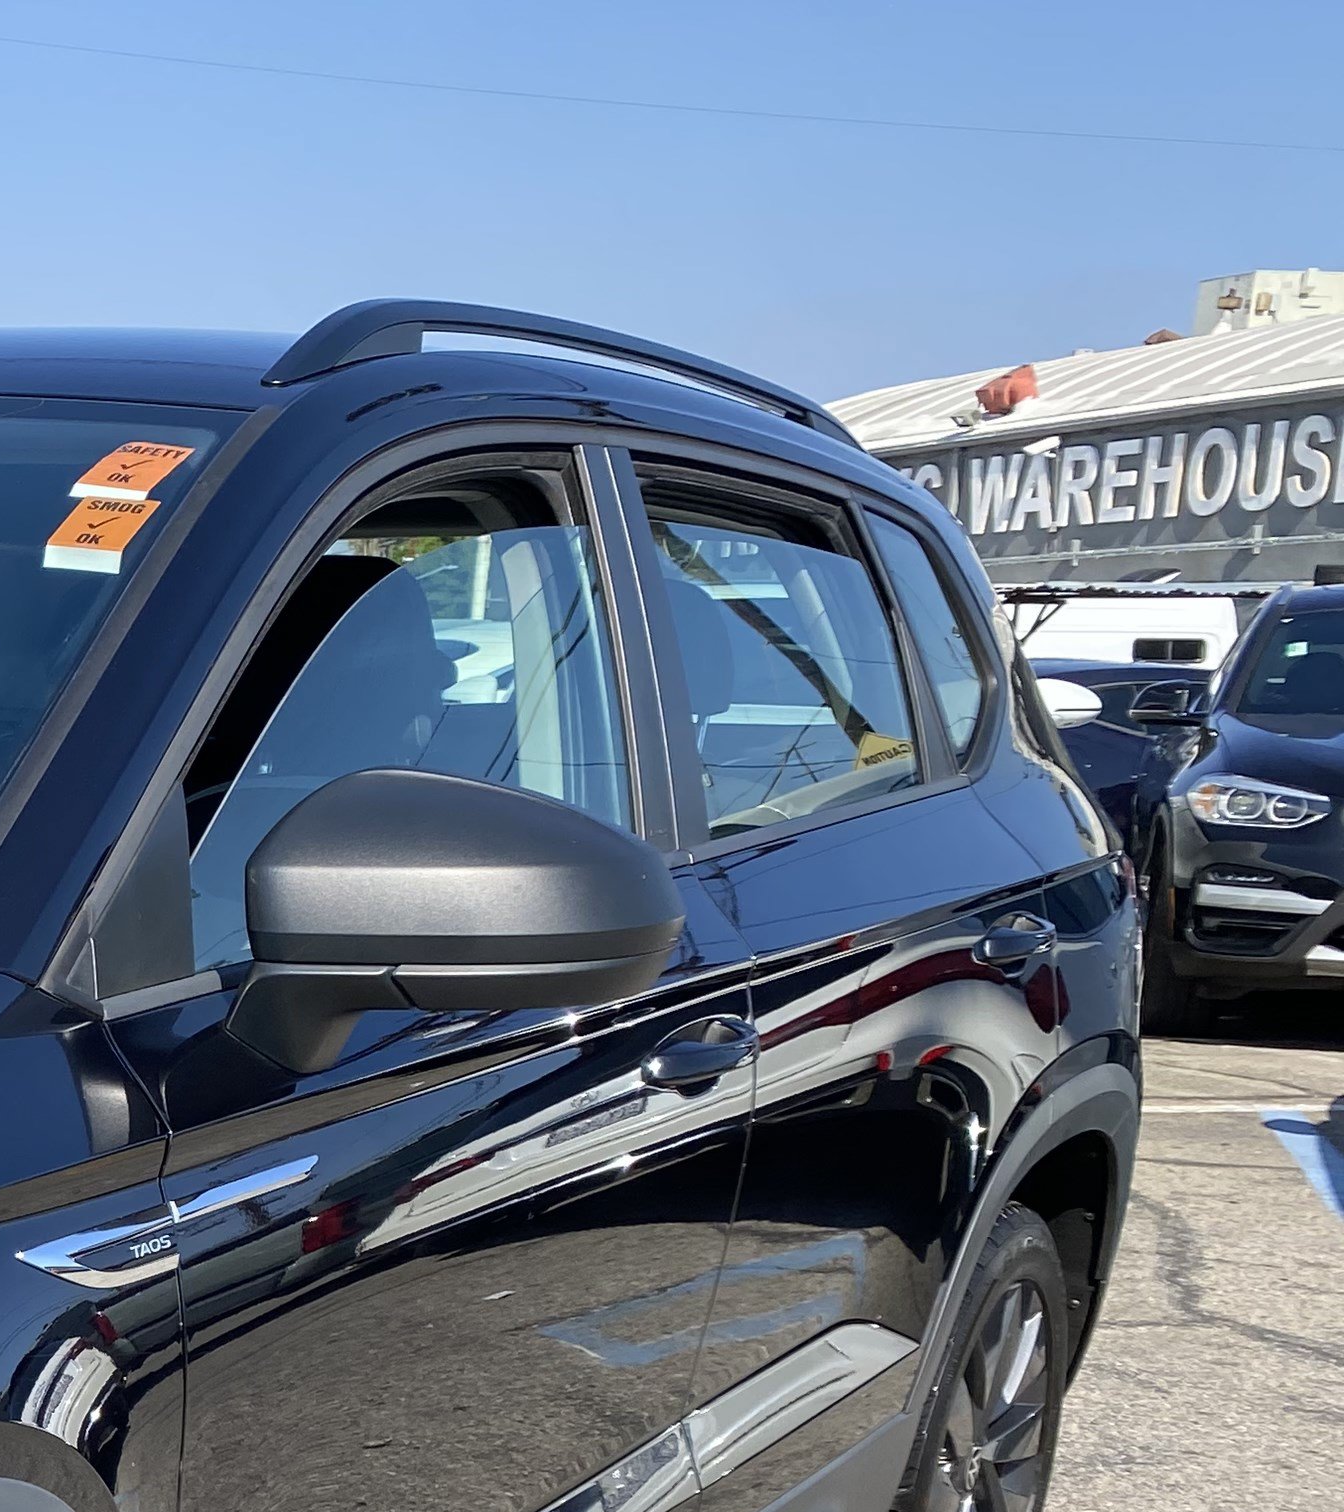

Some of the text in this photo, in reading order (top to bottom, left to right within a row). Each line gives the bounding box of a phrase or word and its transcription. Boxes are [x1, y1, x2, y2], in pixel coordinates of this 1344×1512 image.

[116, 445, 186, 459] SAFETY
[106, 472, 136, 484] OK
[968, 414, 1344, 536] WAREHOUS
[86, 499, 147, 514] SMOG
[75, 533, 105, 545] OK
[129, 1234, 172, 1259] TAOS
